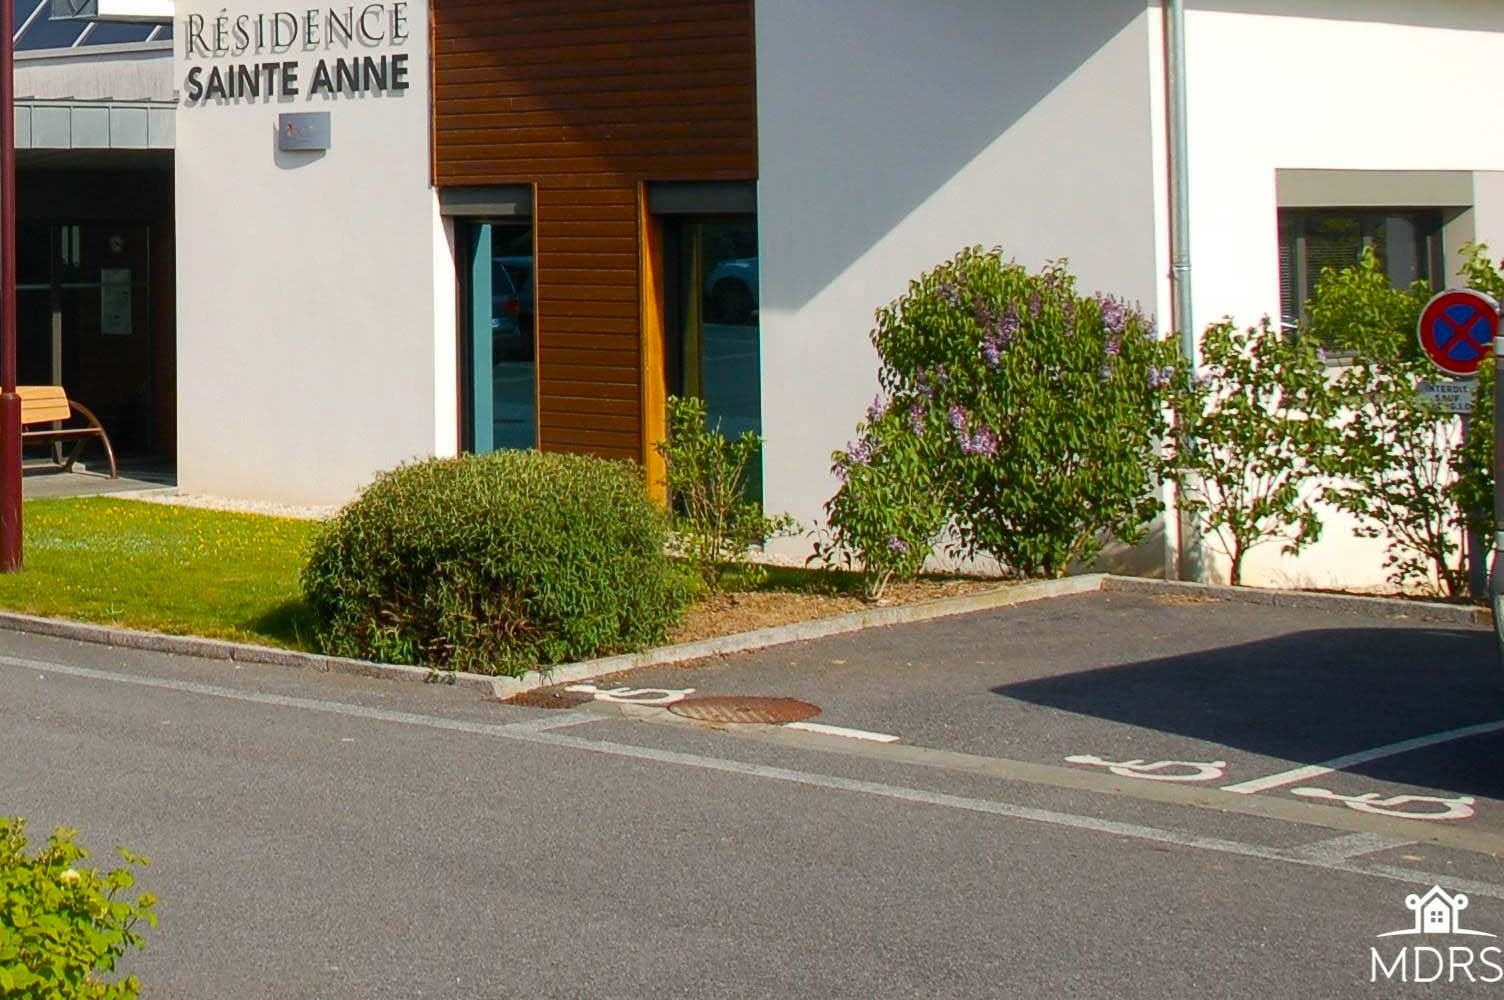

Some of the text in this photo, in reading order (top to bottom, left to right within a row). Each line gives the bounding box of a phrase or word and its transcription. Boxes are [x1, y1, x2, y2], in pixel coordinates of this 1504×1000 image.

[187, 2, 410, 53] RÉSIDENCE
[188, 54, 410, 101] SAINTE ANNE
